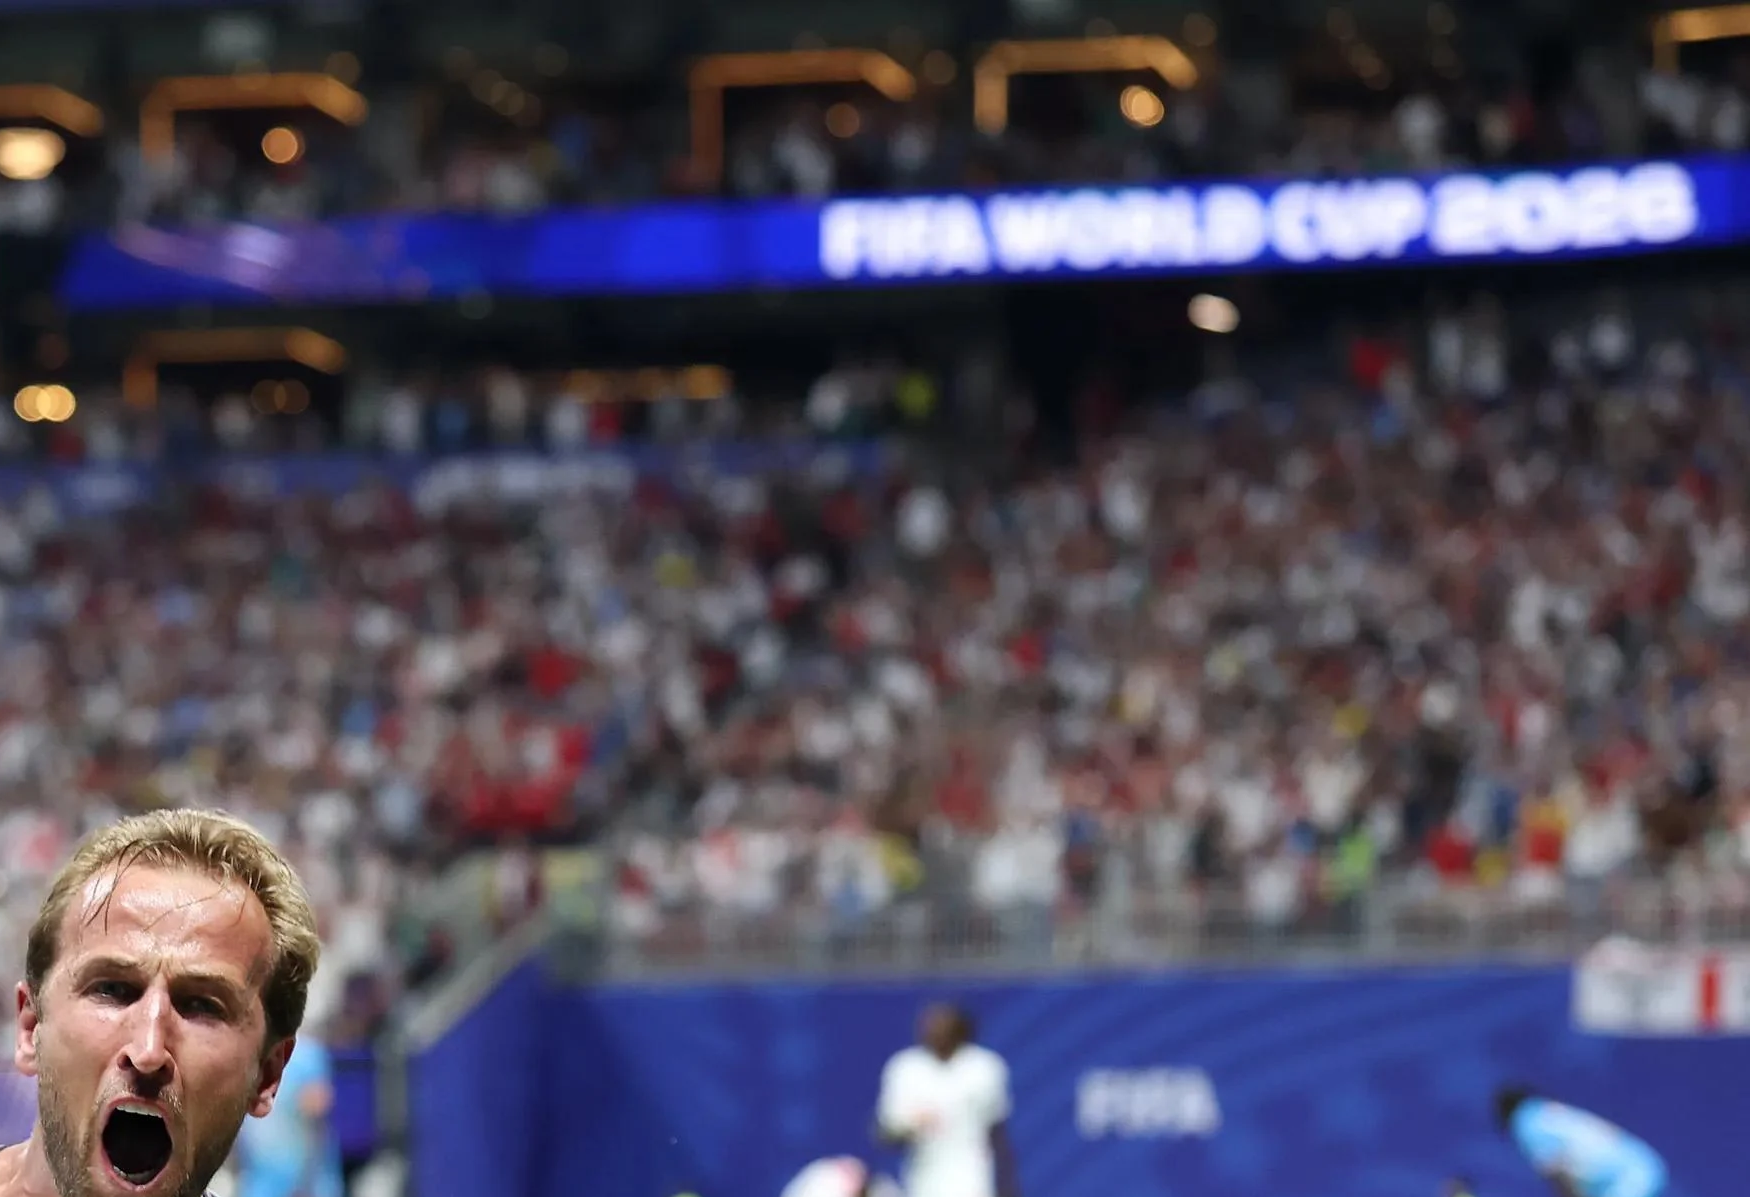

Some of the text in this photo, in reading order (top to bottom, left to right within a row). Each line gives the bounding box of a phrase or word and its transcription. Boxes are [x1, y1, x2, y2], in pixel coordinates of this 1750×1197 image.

[818, 162, 1699, 280] FIFA WORLD CUP 2026
[1074, 1067, 1221, 1138] FIFA
